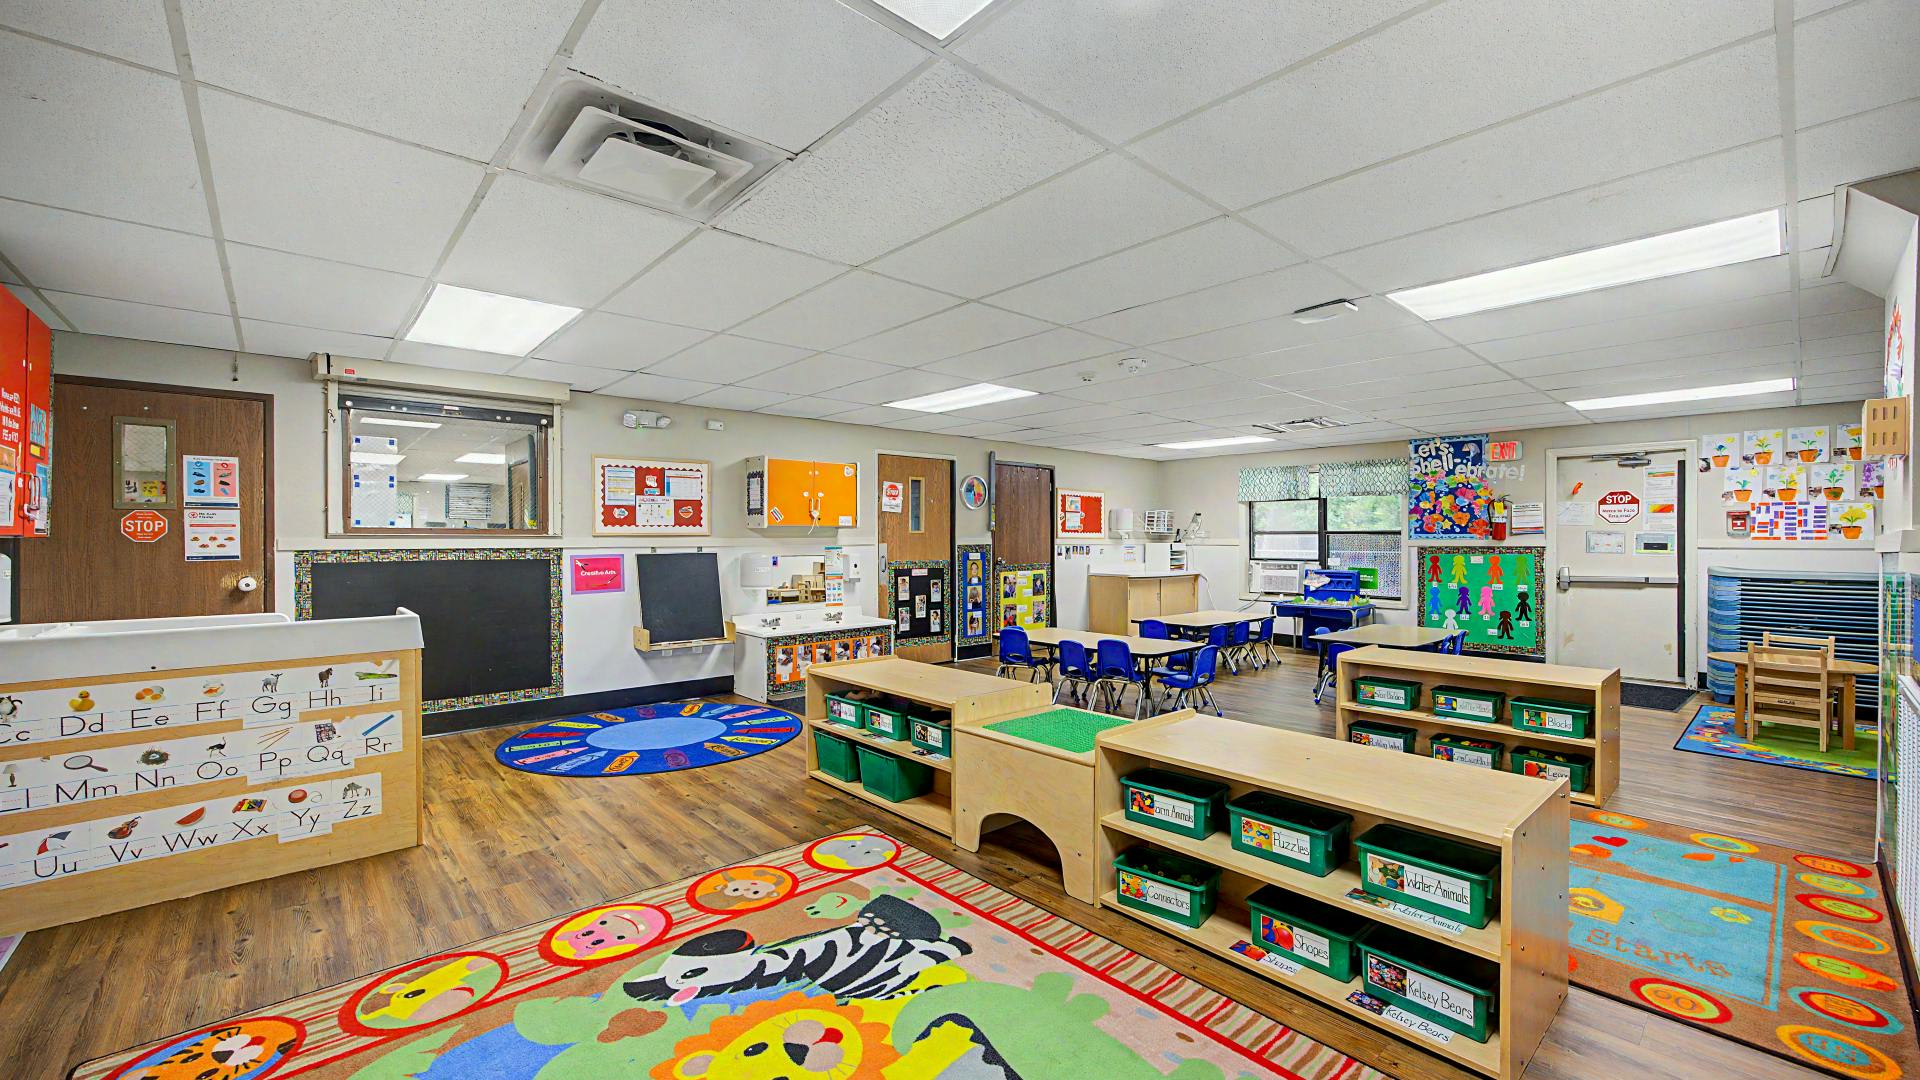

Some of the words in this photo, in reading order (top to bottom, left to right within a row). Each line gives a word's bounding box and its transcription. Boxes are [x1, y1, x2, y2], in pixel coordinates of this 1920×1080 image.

[1491, 441, 1517, 460] EXIT
[1606, 495, 1632, 504] STOP
[125, 520, 164, 532] STOP
[1547, 715, 1573, 729] Blocks
[1171, 804, 1195, 824] Animals
[1272, 831, 1311, 856] Puzzles
[1146, 885, 1191, 910] Connectors
[1404, 869, 1434, 893] Water
[1434, 880, 1470, 905] Animals
[1293, 933, 1329, 961] Shapes
[1586, 928, 1734, 978] Starts
[1263, 953, 1299, 975] Shapes
[1407, 978, 1439, 1009] Kelsey
[1441, 992, 1473, 1020] Bears
[1385, 1007, 1417, 1029] Kelsey
[1418, 1021, 1451, 1042] Bears
